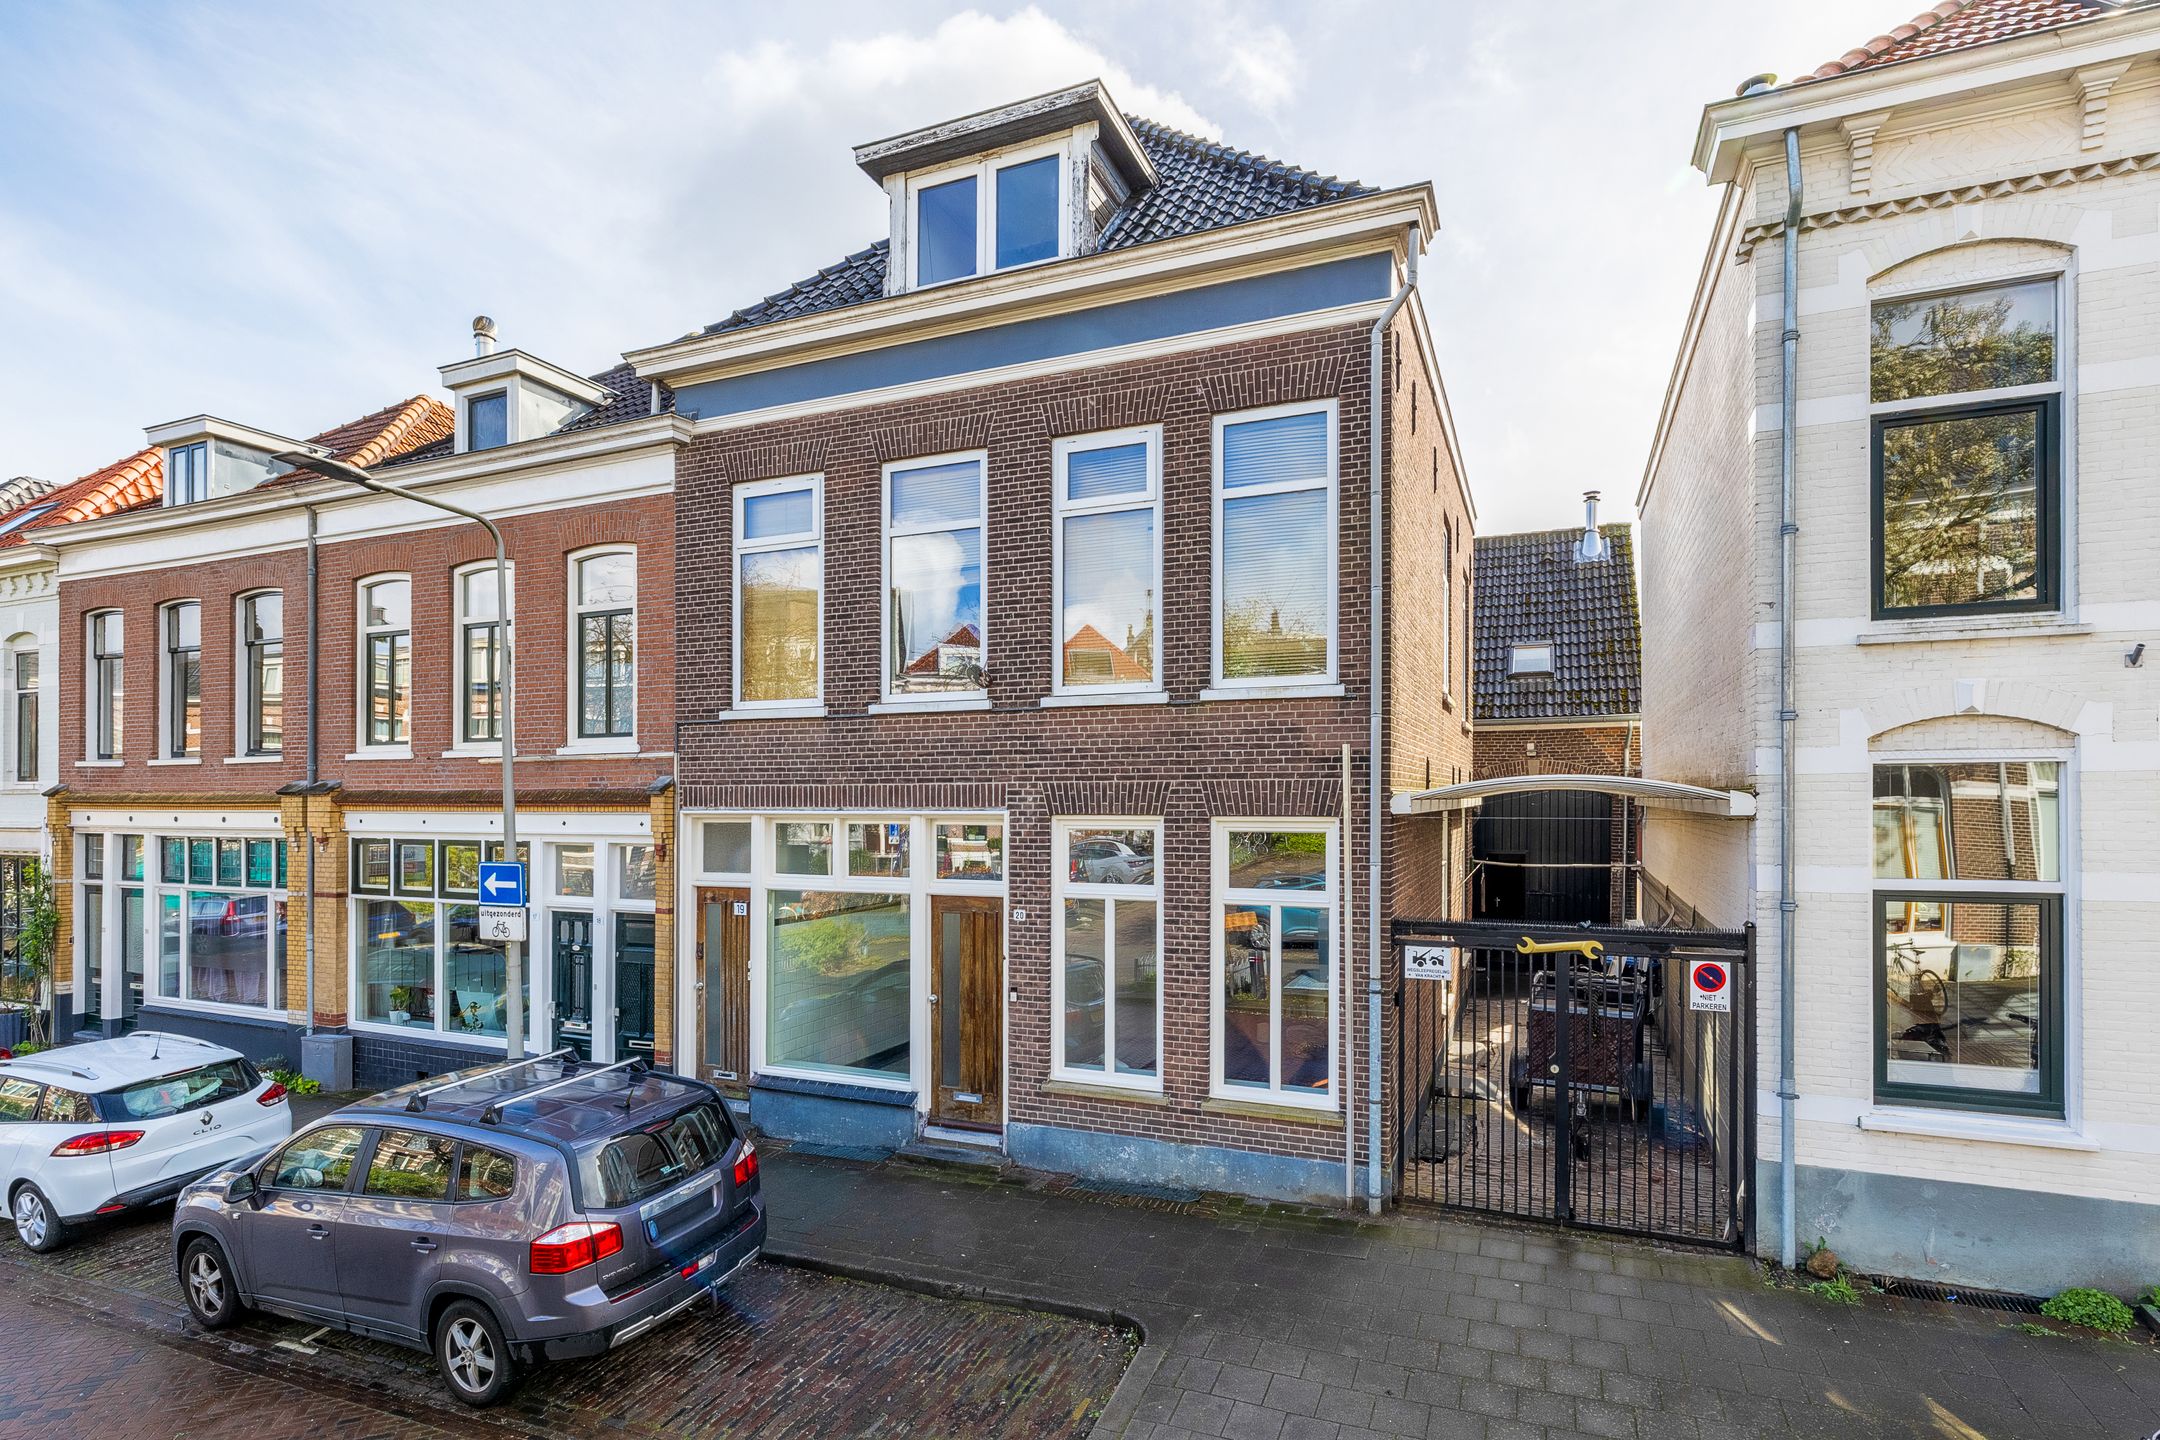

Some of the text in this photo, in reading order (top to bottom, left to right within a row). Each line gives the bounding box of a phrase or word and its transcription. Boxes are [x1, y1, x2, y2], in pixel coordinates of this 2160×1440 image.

[480, 909, 521, 918] uitgezonderd
[736, 904, 745, 914] 19
[1015, 911, 1024, 920] 20
[1407, 967, 1450, 975] WEGSLEEPREGELING
[1692, 1002, 1727, 1010] PARKEREN
[193, 1124, 222, 1135] CLIO
